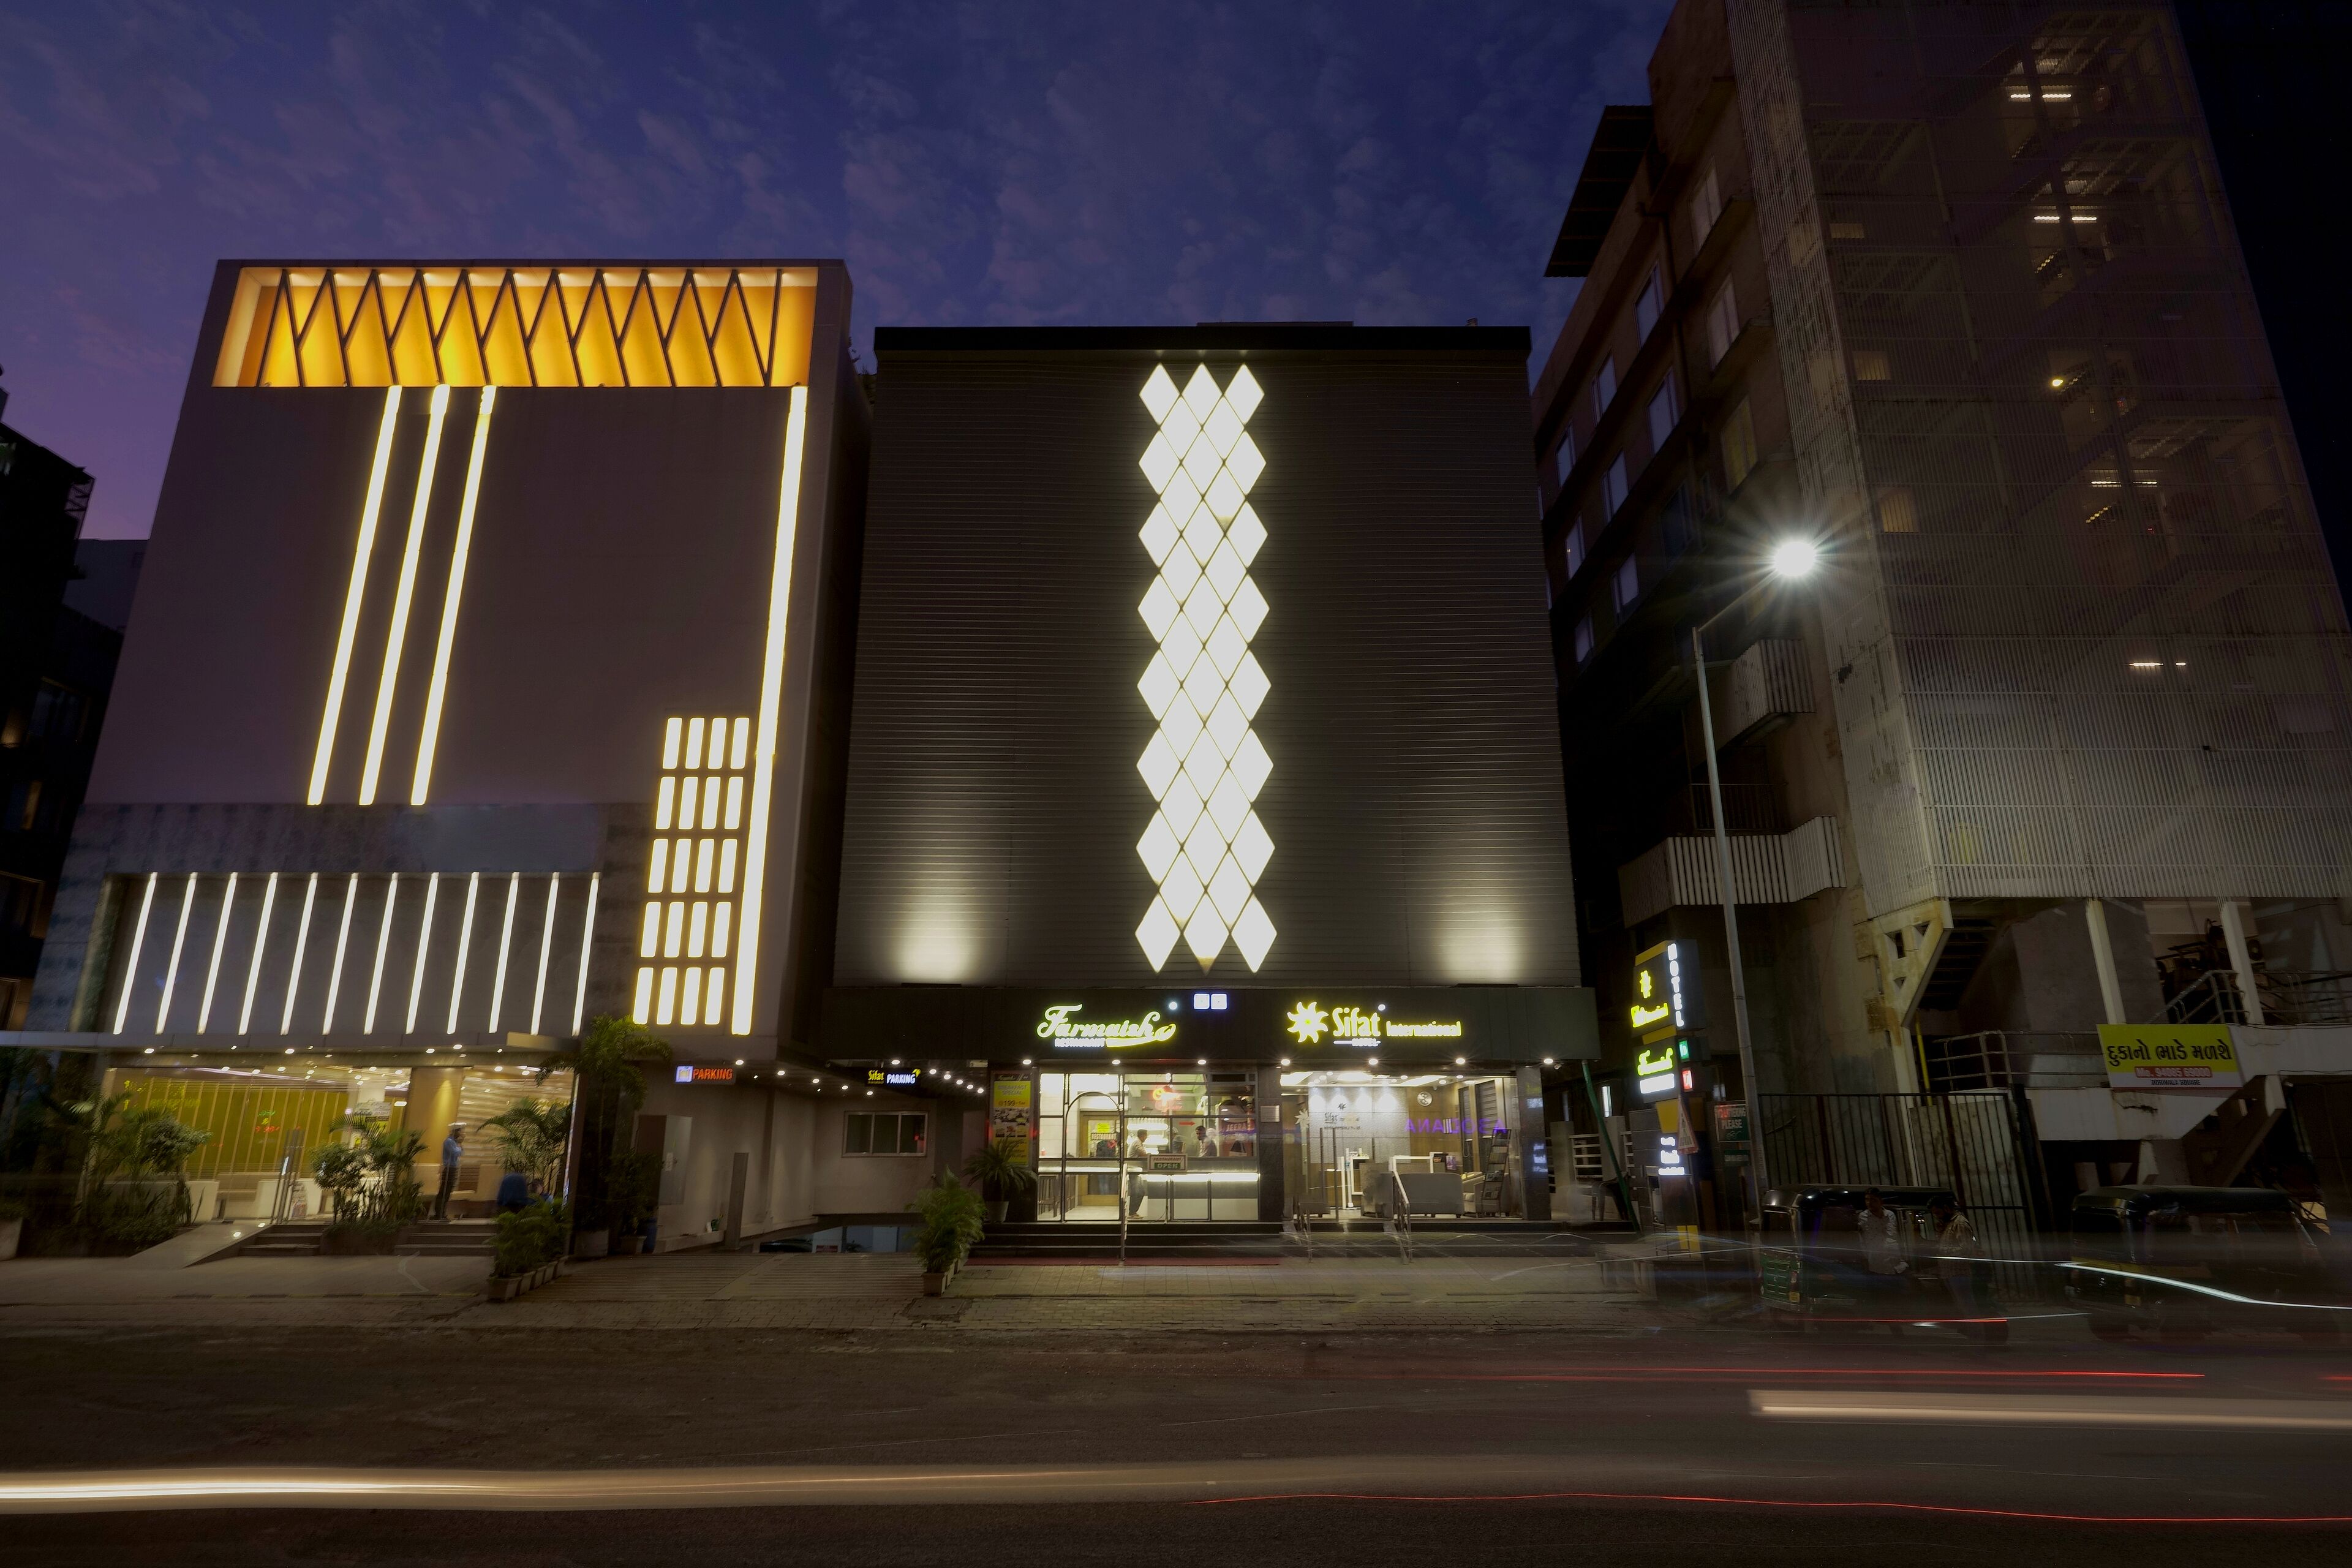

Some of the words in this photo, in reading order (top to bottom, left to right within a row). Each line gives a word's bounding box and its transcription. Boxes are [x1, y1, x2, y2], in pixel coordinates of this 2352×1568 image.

[1667, 943, 1684, 1027] HOTEL
[1037, 1003, 1161, 1039] Farmaish
[1332, 1008, 1381, 1037] Sifat
[1385, 1020, 1462, 1037] International
[2107, 1038, 2151, 1066] દુકાનો
[2155, 1038, 2188, 1060] ભાડે
[2190, 1038, 2233, 1060] મળશે
[692, 1068, 733, 1080] PARKING
[867, 1069, 885, 1081] Sifat
[886, 1074, 916, 1084] PARKING
[1721, 1119, 1743, 1129] PLEASE
